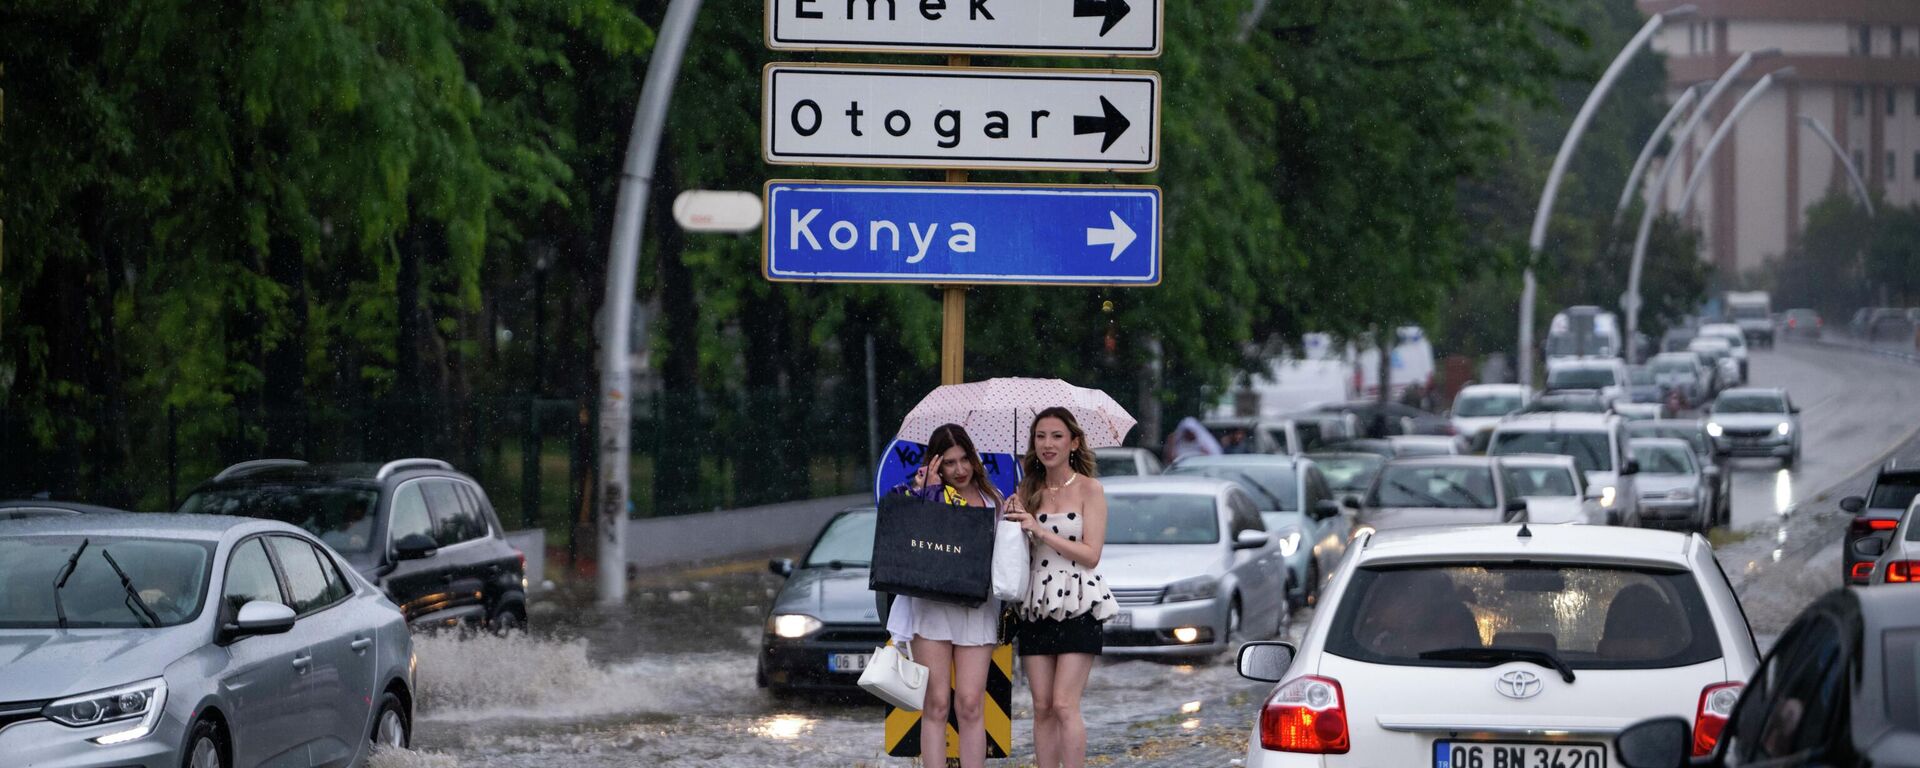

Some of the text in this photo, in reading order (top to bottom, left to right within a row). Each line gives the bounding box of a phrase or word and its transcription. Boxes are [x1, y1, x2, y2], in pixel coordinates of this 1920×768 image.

[795, 0, 995, 21] Emek
[790, 98, 1050, 148] Otogar
[790, 208, 976, 264] Konya
[911, 539, 962, 554] BEYMEN
[835, 655, 849, 668] 06
[1451, 745, 1483, 768] 06
[1493, 746, 1525, 768] BN
[1534, 748, 1600, 768] 3420
